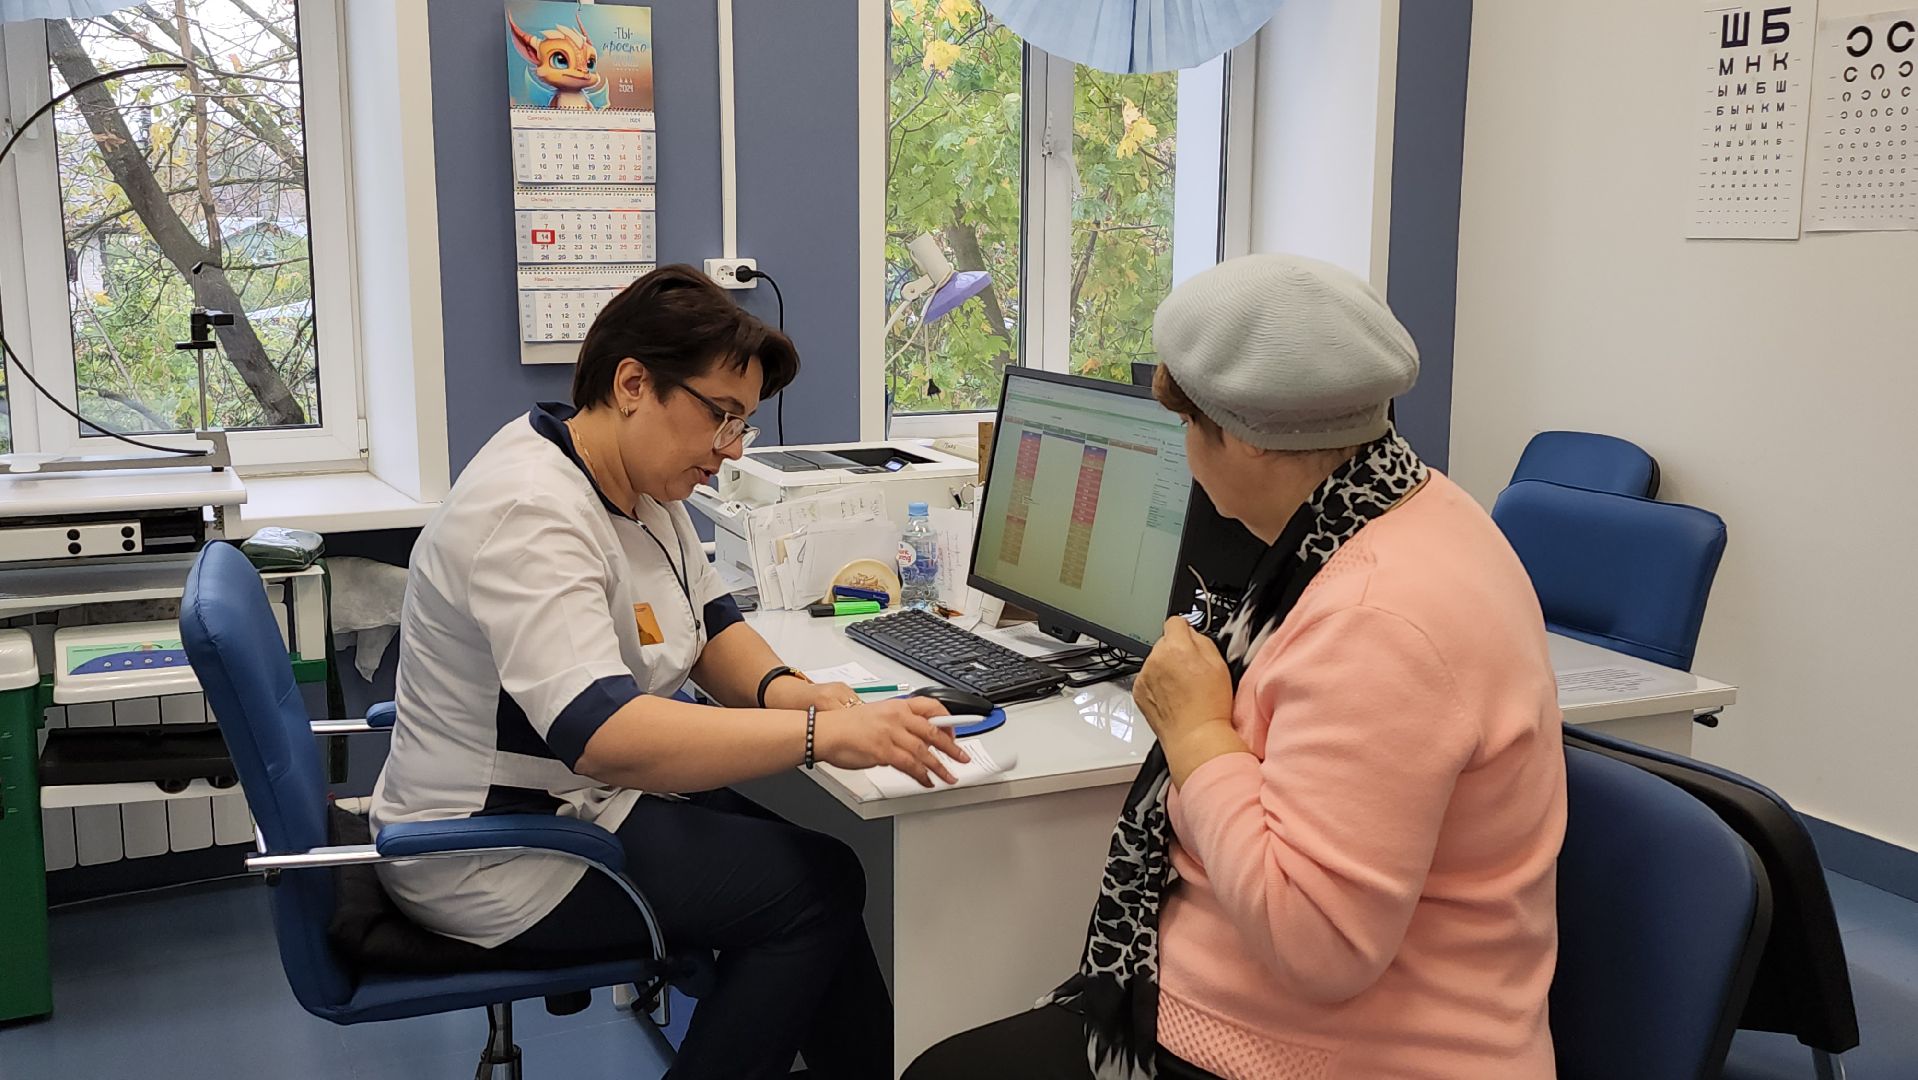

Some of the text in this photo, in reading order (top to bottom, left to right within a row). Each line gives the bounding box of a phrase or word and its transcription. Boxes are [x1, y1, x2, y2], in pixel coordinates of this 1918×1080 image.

[1720, 6, 1792, 48] Ш Б
[1719, 52, 1789, 76] М Н К
[1718, 80, 1786, 97] Ы М Б Ш
[1717, 103, 1784, 115] Б Ы Н К М
